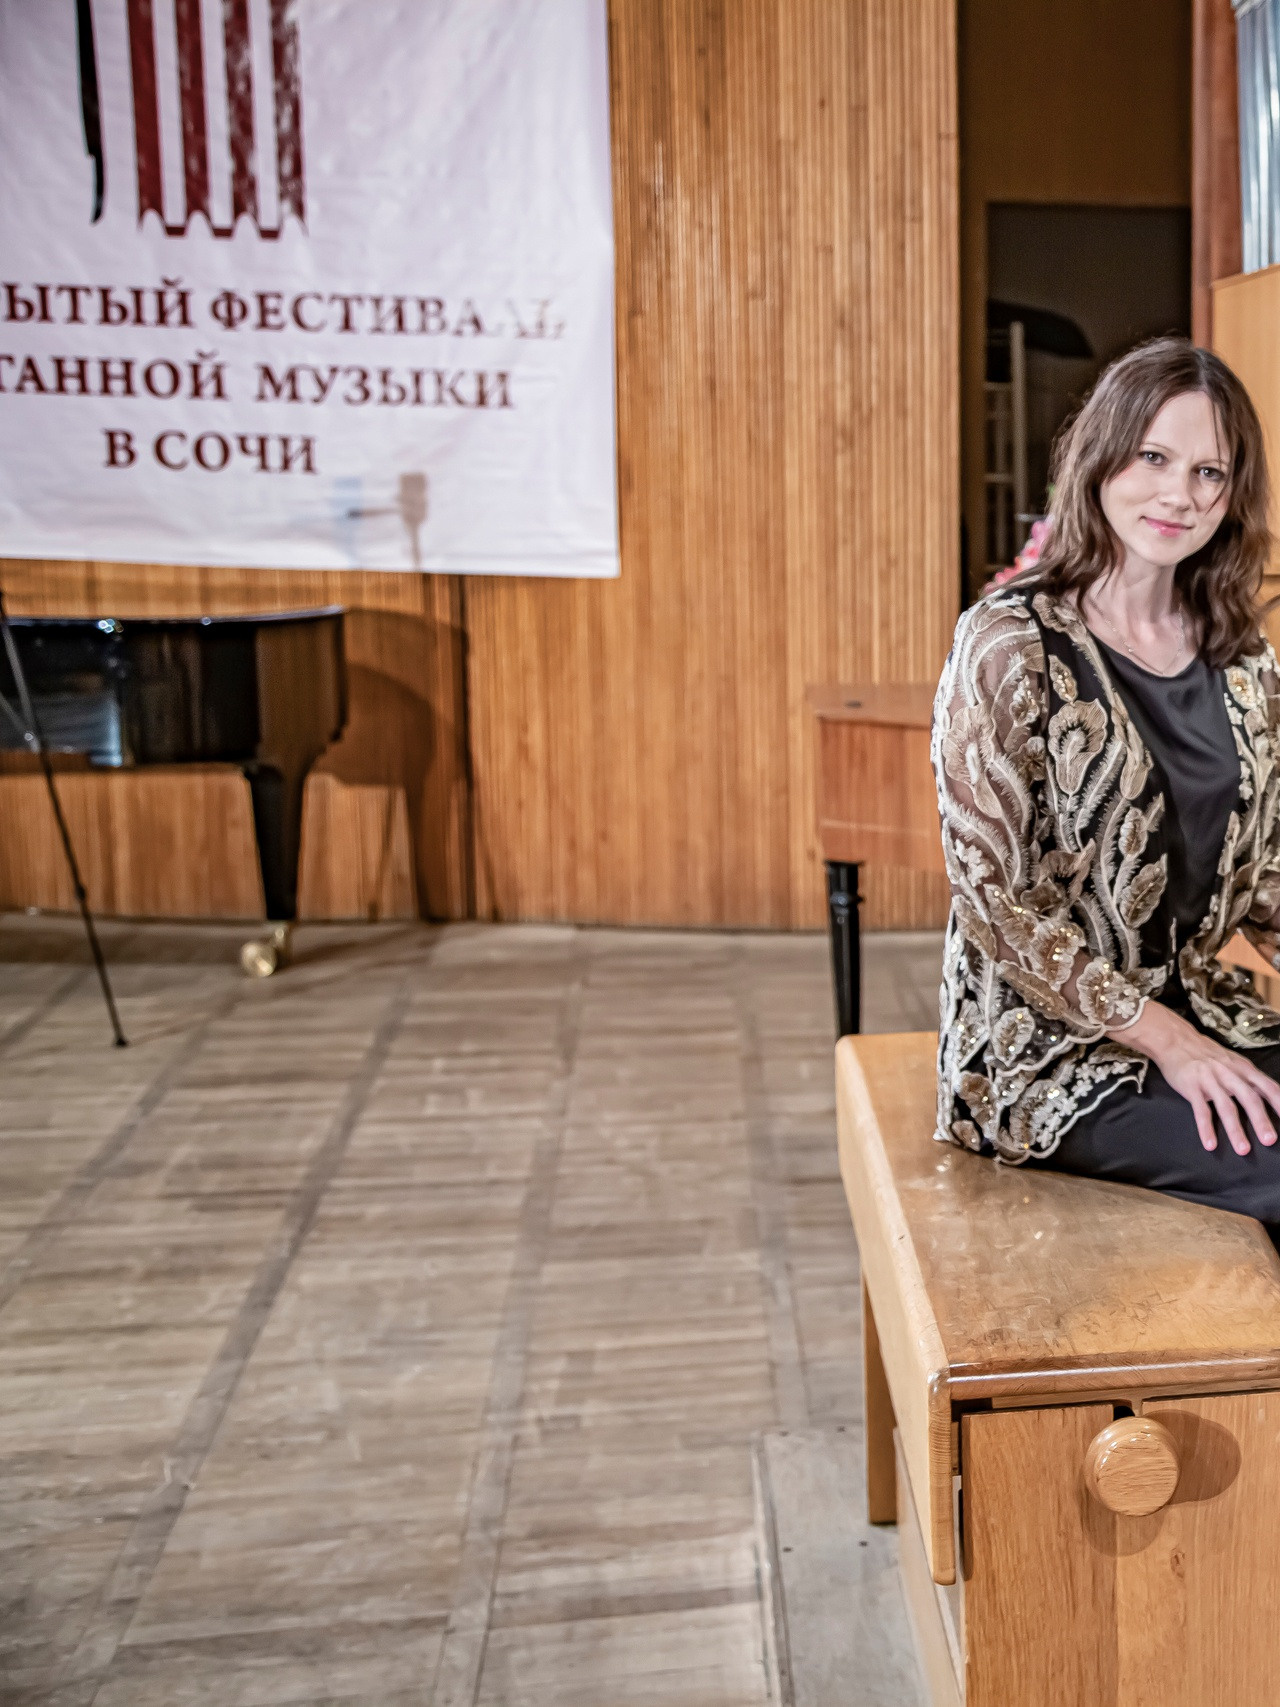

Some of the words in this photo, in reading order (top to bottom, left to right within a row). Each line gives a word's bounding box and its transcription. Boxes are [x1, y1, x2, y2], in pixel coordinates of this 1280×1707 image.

[255, 362, 514, 409] МУЗЫКИ
[105, 430, 138, 469] В
[154, 430, 319, 475] СОЧИ
